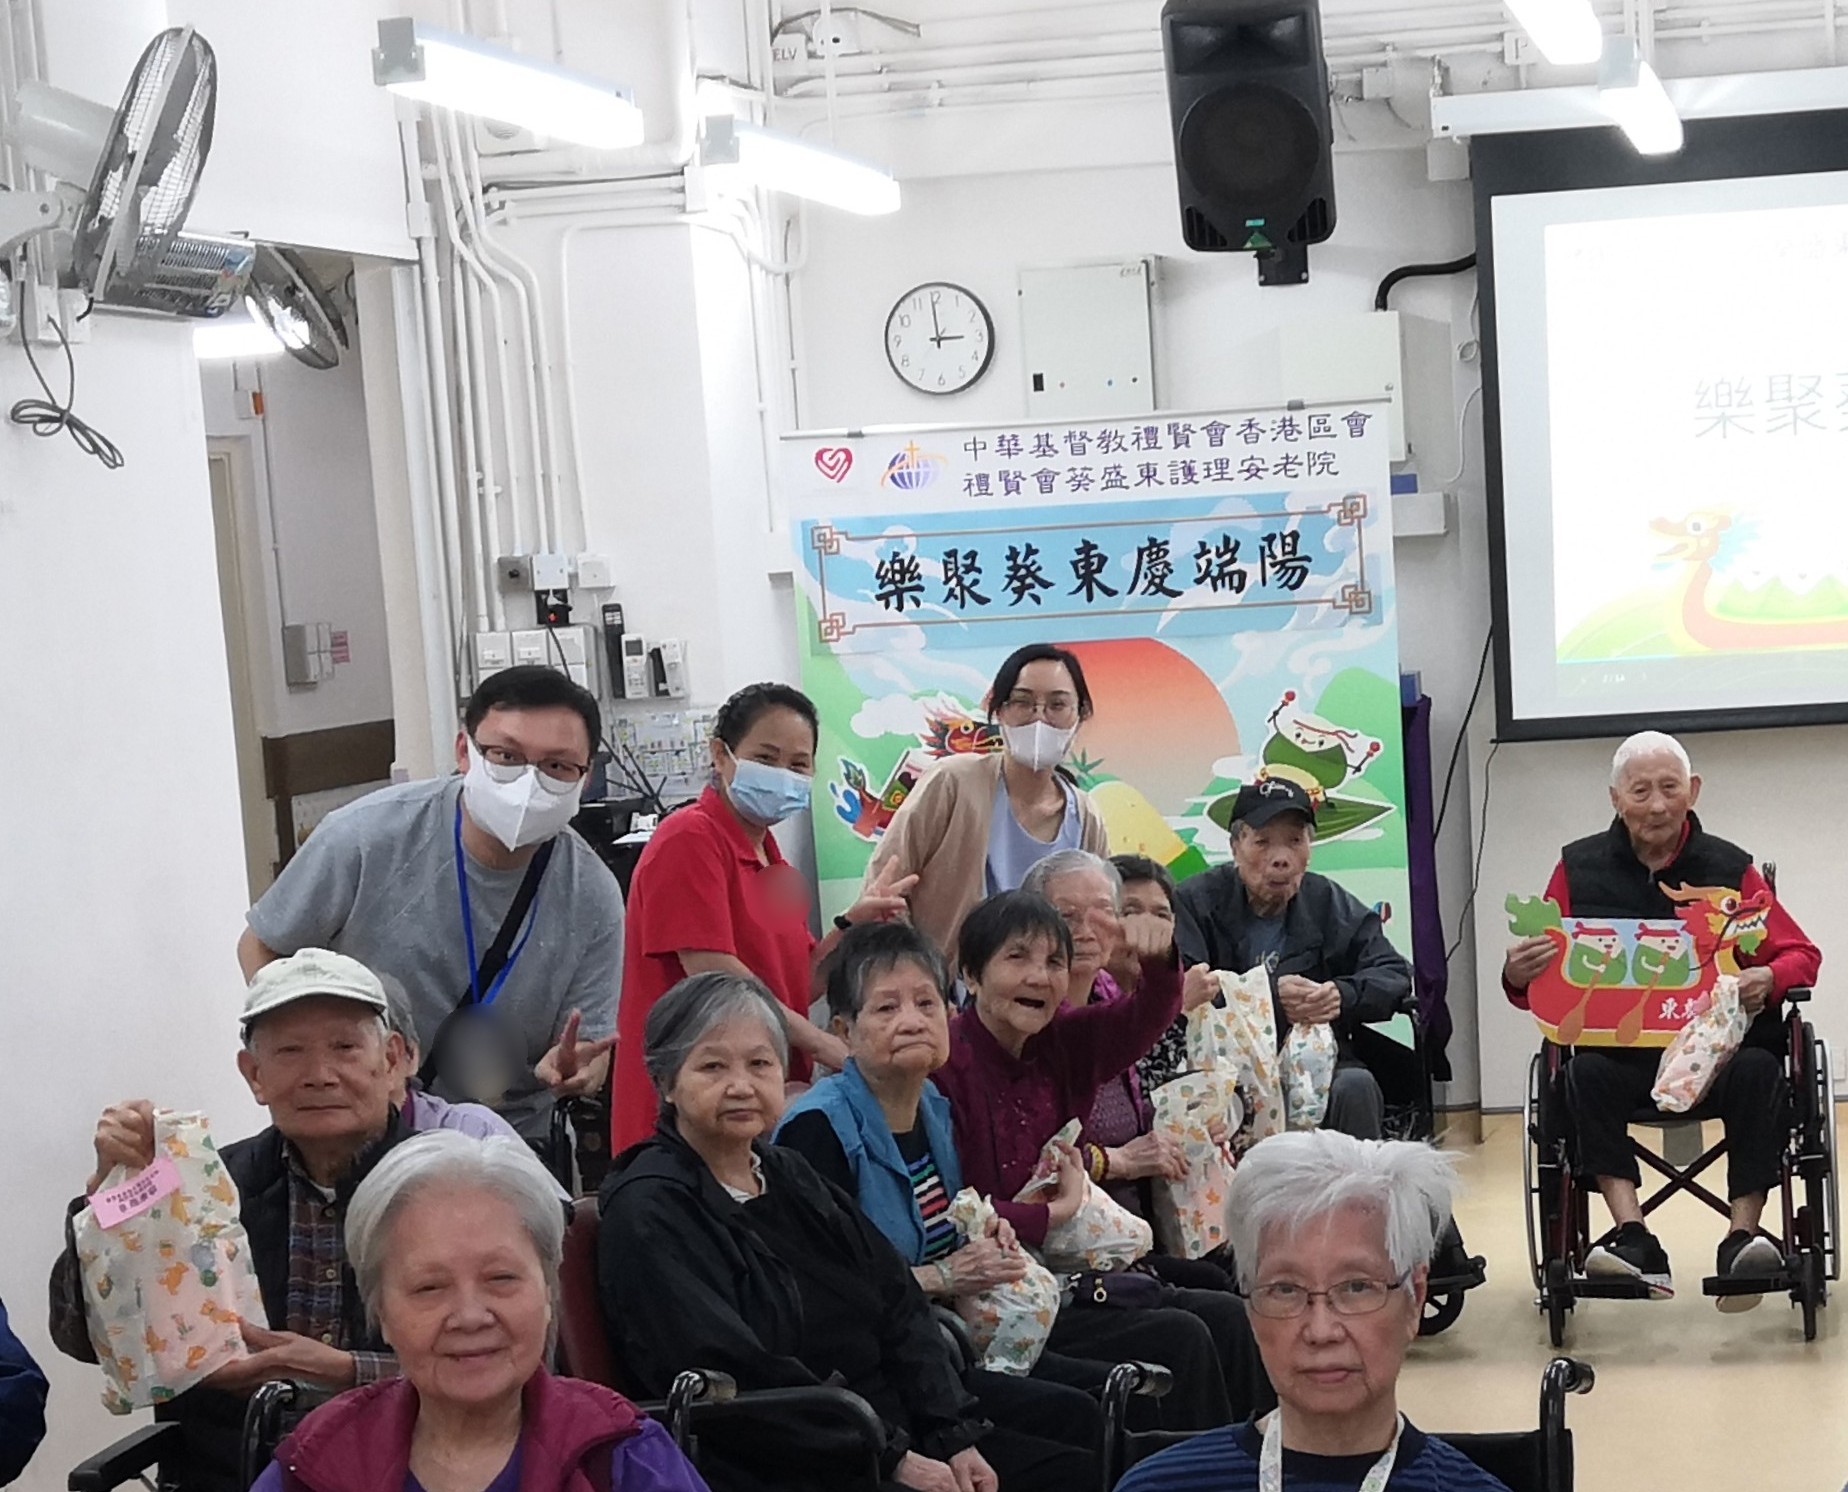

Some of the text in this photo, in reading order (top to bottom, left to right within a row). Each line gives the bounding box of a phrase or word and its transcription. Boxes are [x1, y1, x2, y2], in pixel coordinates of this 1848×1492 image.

[962, 410, 1373, 463] 中華基督教禮賢會香港區會
[962, 450, 1340, 499] 禮賢會葵盛東護理安老院
[873, 529, 1313, 613] 樂聚葵東慶端陽
